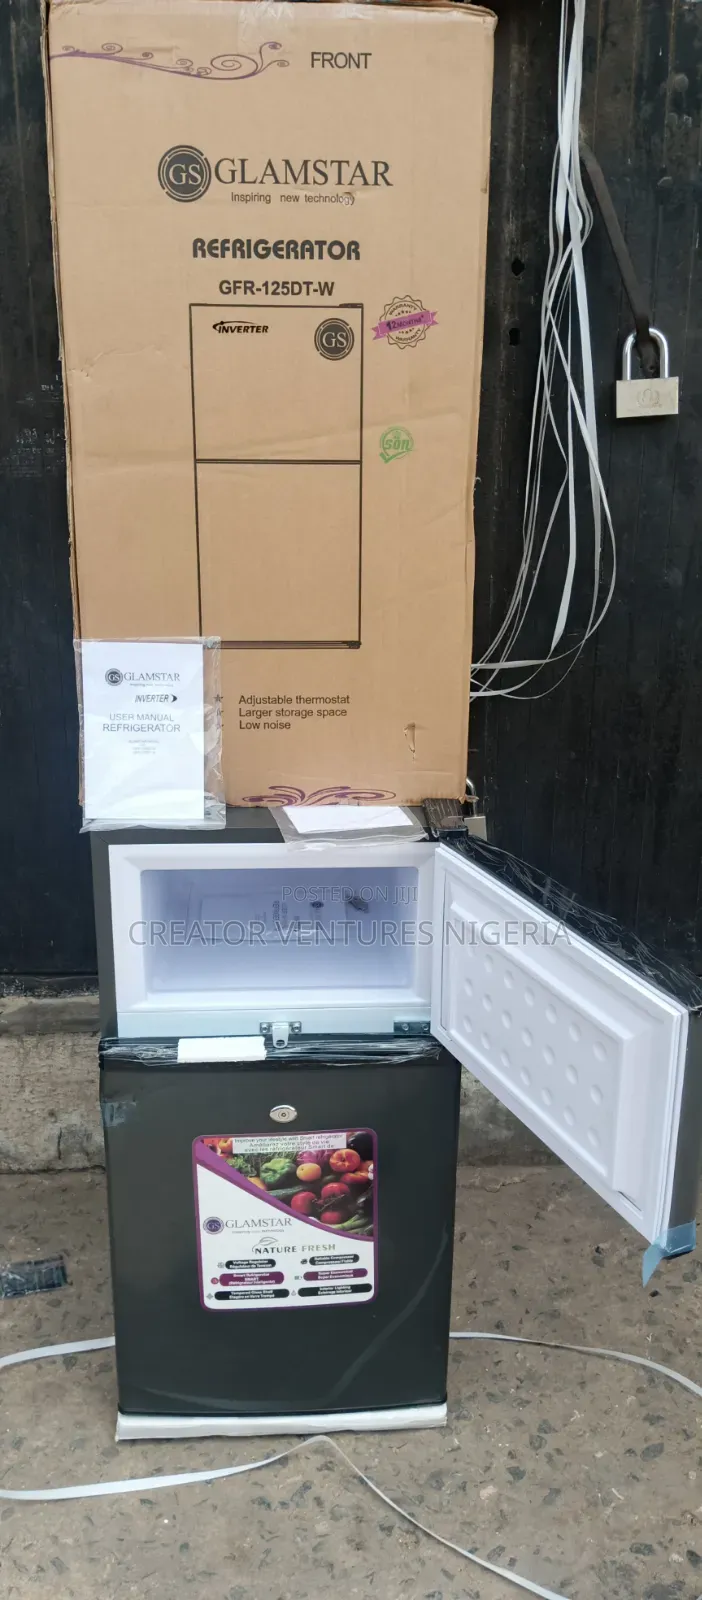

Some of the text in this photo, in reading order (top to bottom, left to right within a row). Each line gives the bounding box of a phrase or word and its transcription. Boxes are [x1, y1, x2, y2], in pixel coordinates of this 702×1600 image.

[310, 52, 372, 69] FRONT
[168, 158, 394, 188] GS GLAMSTAR
[231, 192, 355, 206] Inspiring new technology
[192, 238, 361, 260] REFRIGERATOR
[218, 280, 335, 297] GFR-125DT-W
[218, 324, 269, 334] INVERTER
[322, 331, 348, 348] GS
[123, 672, 181, 682] GLAMSTAR
[135, 693, 170, 703] INVERTER
[238, 695, 350, 707] Adjustable thermostat
[109, 713, 175, 722] USER MANUAL
[238, 708, 348, 719] Larger storage space
[102, 723, 181, 733] REFRIGERATOR
[239, 720, 291, 730] Low noise
[225, 1217, 292, 1229] GLAMSTAR
[254, 1243, 336, 1255] NATURE FRESH
